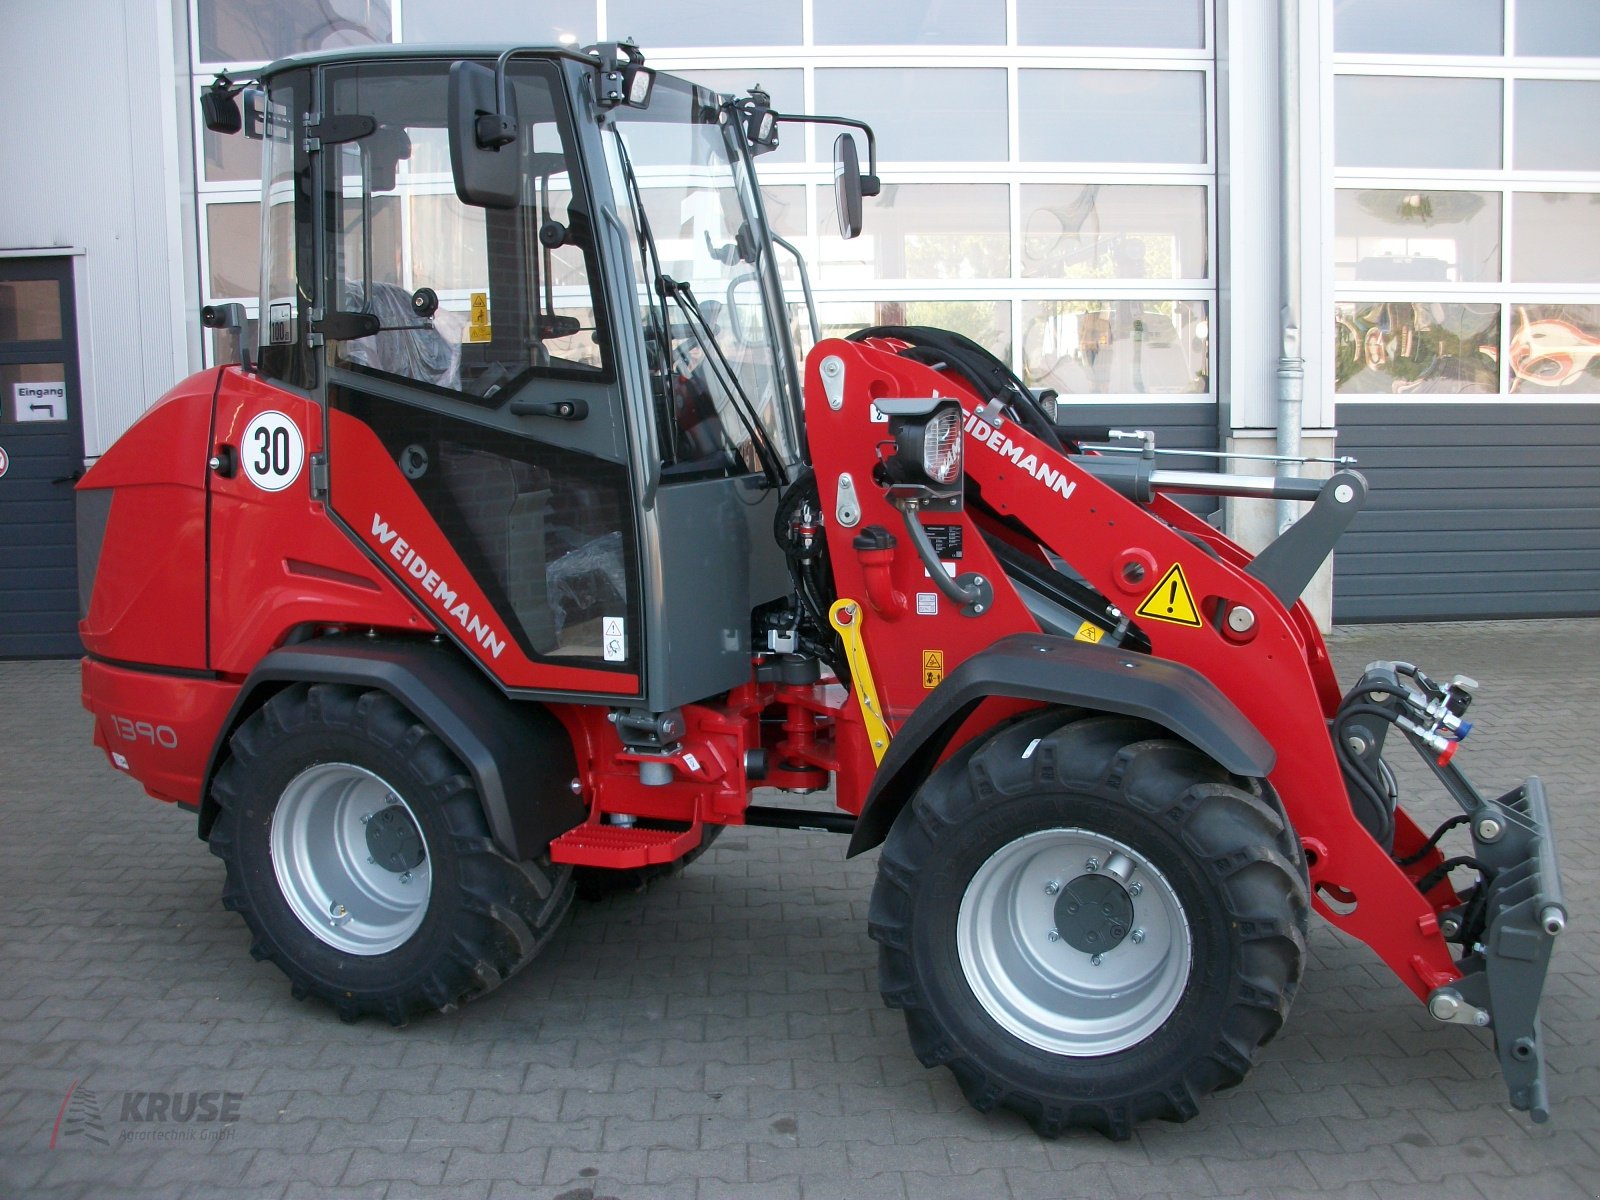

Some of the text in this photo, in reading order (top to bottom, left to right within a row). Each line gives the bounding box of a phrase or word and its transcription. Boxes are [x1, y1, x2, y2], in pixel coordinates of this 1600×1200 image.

[18, 388, 64, 398] Eingang
[254, 426, 290, 476] 30
[932, 389, 1077, 500] IDEMANN
[371, 512, 506, 659] WEIDEMANN
[110, 714, 178, 749] 1390
